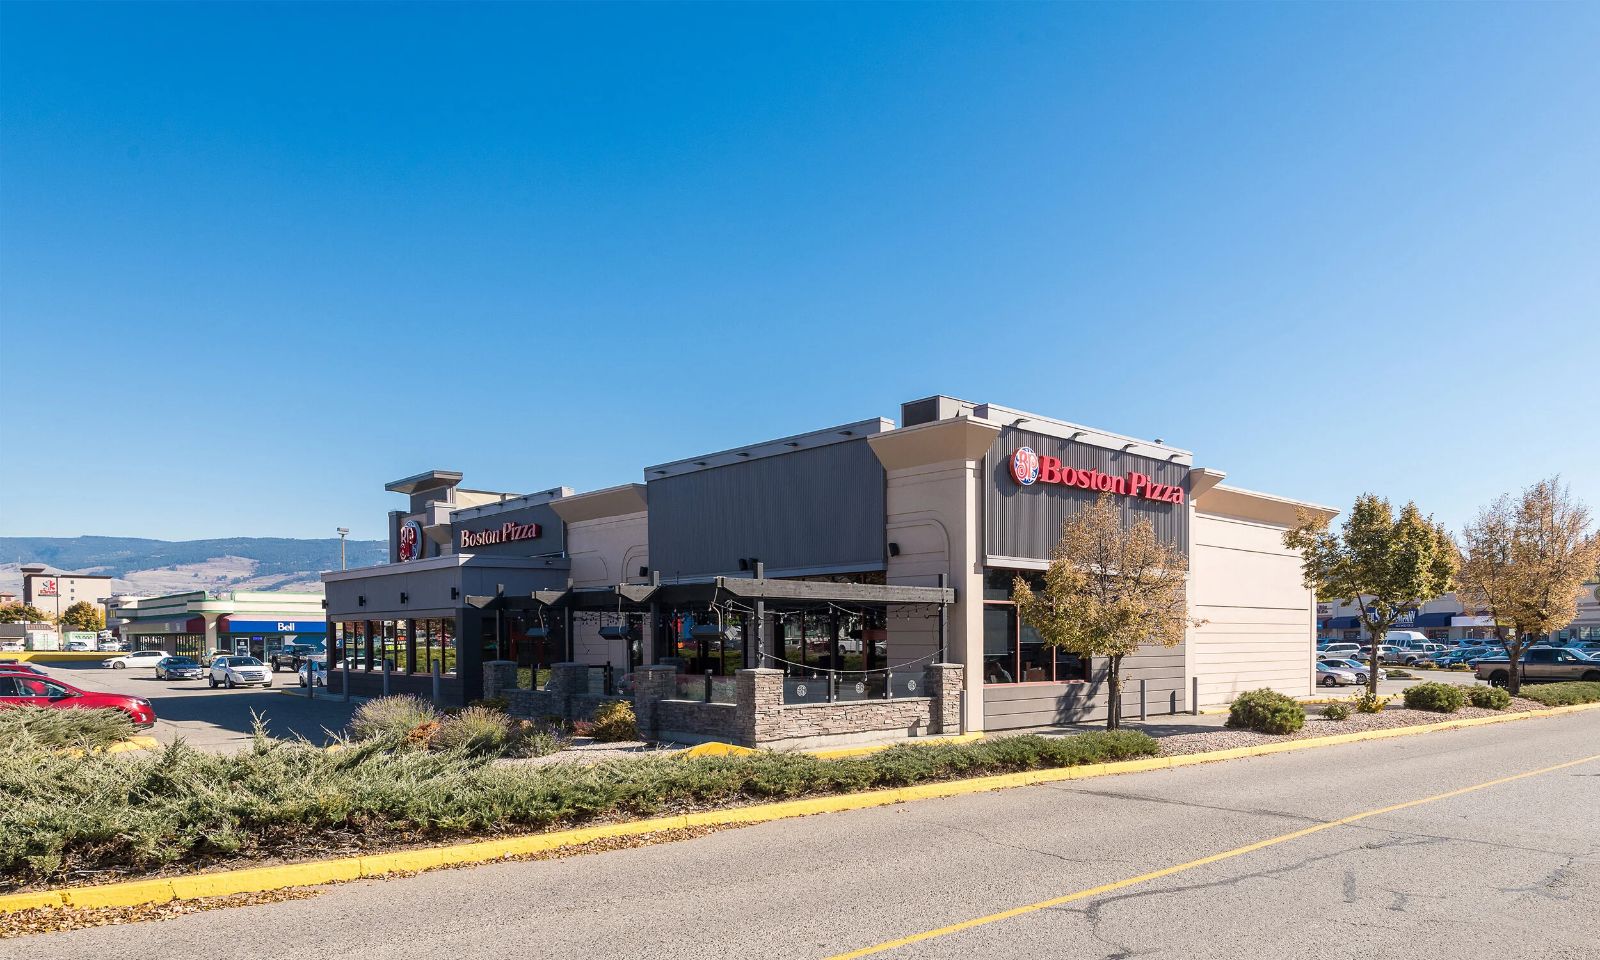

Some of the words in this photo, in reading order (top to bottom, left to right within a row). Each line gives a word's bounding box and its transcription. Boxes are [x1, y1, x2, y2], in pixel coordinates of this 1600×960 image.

[1040, 455, 1126, 495] Boston
[1129, 472, 1185, 505] Pizza
[461, 529, 500, 548] Boston
[502, 522, 537, 542] Pizza
[277, 622, 295, 632] Bell
